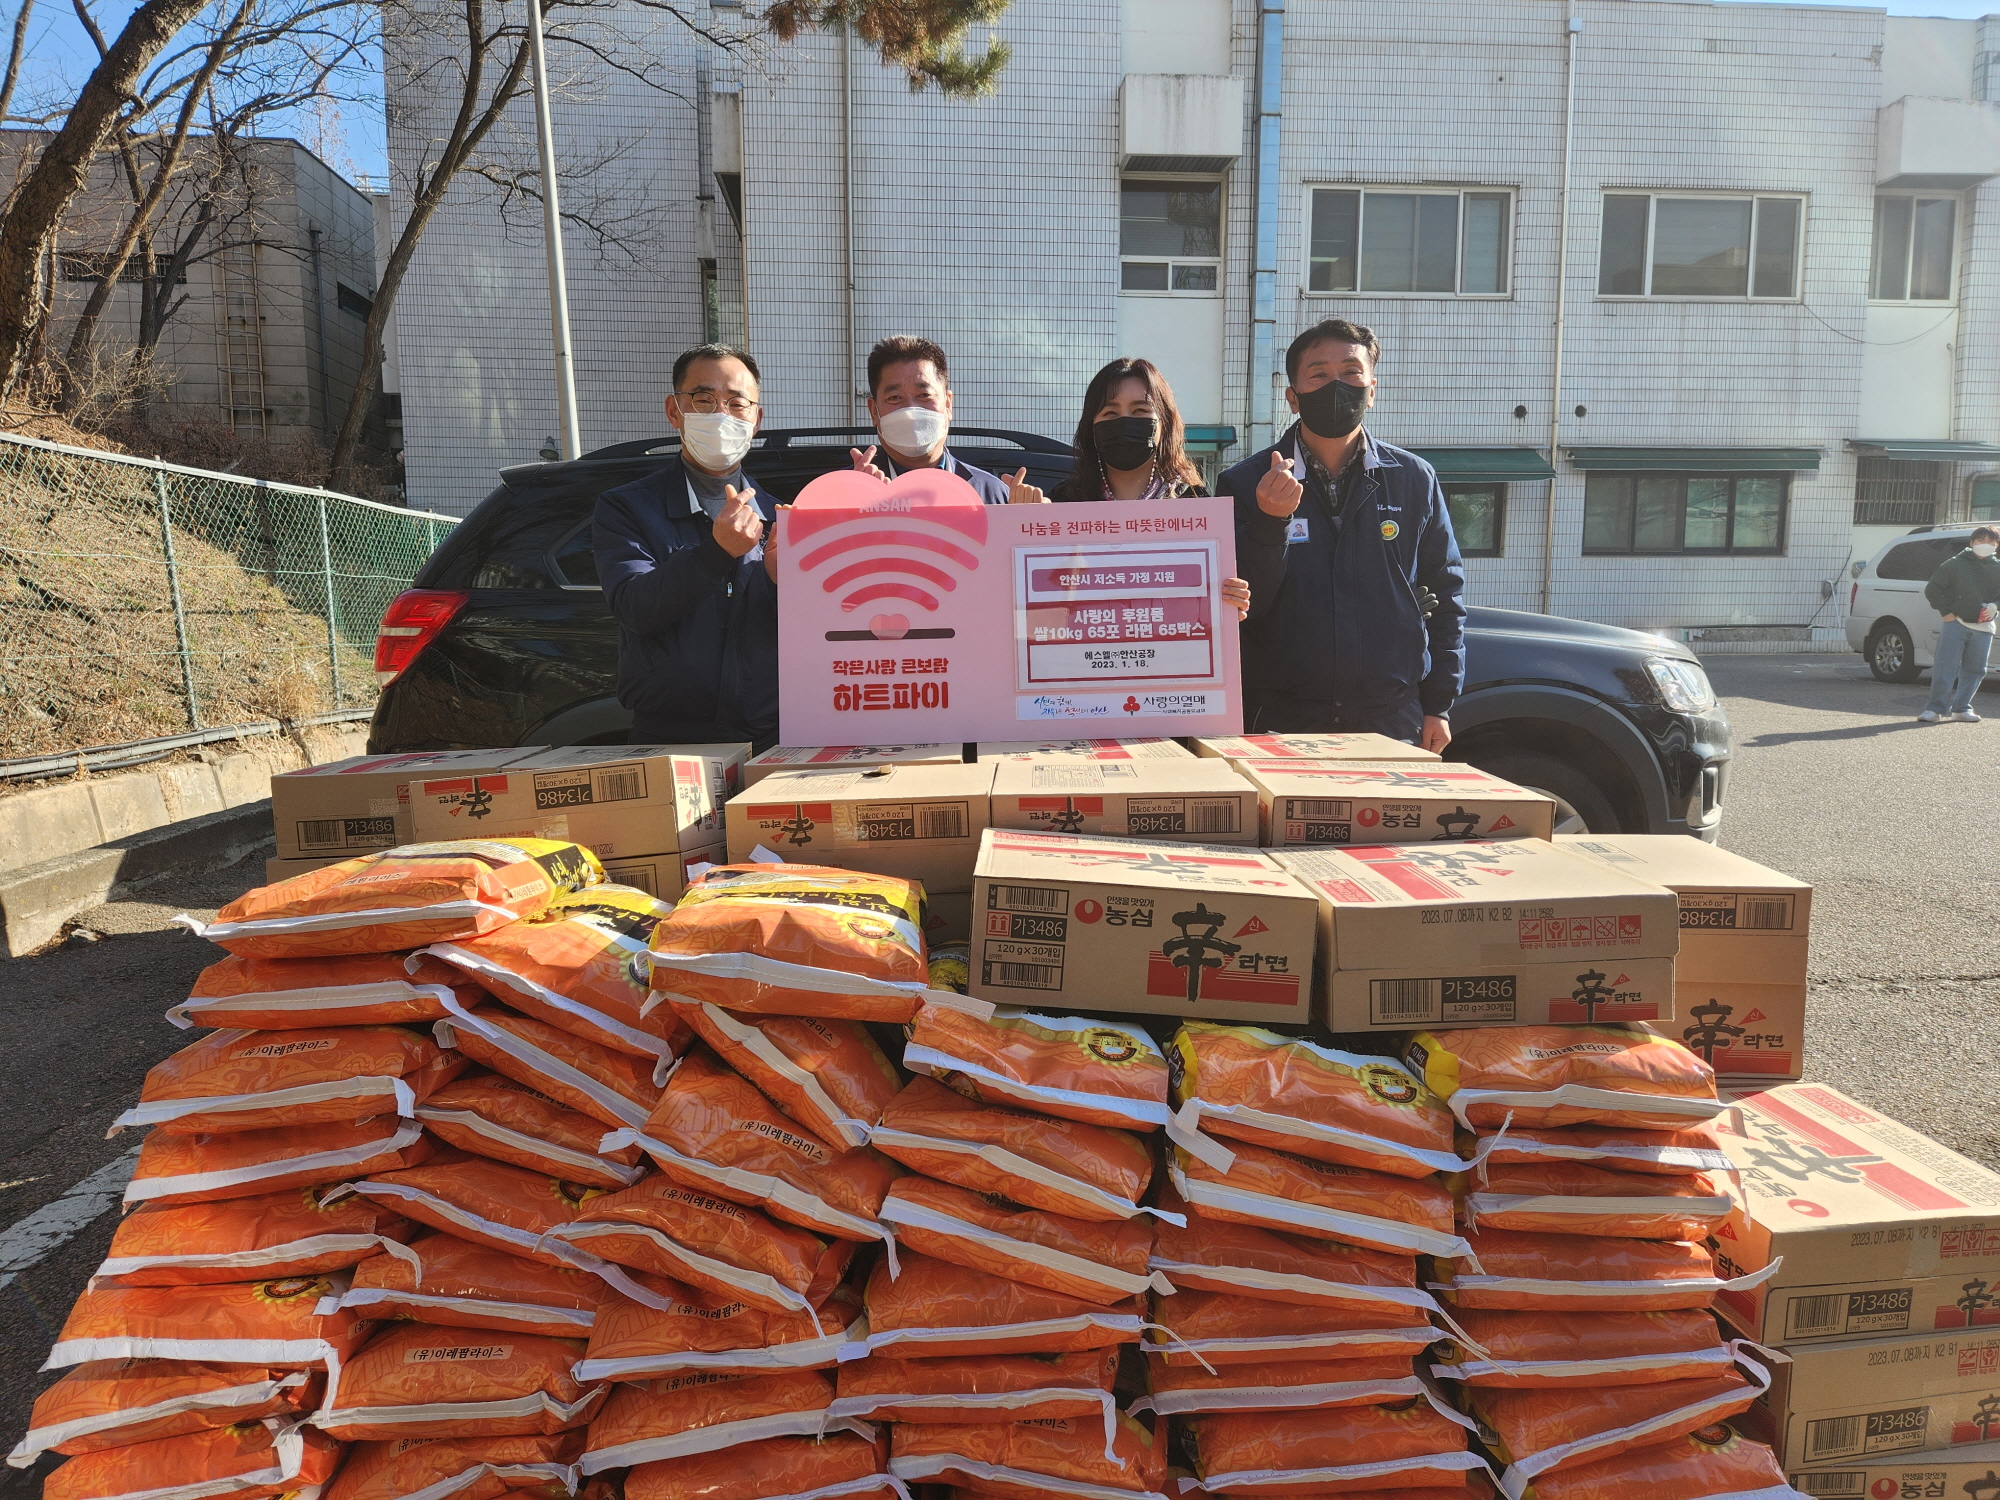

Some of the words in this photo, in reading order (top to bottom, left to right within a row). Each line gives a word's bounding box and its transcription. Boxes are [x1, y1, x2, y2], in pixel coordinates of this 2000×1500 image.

[859, 498, 911, 513] ANSAN
[1021, 521, 1062, 537] 나눔을
[1067, 519, 1121, 535] 전파하는
[1125, 516, 1208, 533] 따뜻한에너지
[1059, 573, 1091, 586] 안산시
[1094, 571, 1126, 585] 저소득
[1129, 571, 1151, 584] 가정
[1153, 570, 1175, 583] 지원
[1074, 608, 1116, 625] 사랑의
[1122, 607, 1164, 623] 후원품
[1033, 626, 1083, 642] 쌀10kg
[1087, 625, 1120, 640] 65포
[1125, 624, 1153, 638] 라면
[1158, 622, 1206, 637] 65박스
[900, 657, 949, 674] 큰보람
[1091, 660, 1118, 669] 2023.
[1121, 660, 1131, 669] 1.
[1134, 659, 1149, 668] 18.
[832, 681, 949, 712] 하트파이
[1143, 695, 1206, 709] 사랑의열매
[438, 794, 459, 804] 라면
[538, 787, 590, 806] 가3486
[1029, 811, 1052, 821] 라면
[1382, 804, 1401, 812] 인생을
[1402, 804, 1422, 813] 맛있게
[347, 820, 393, 834] 가3486
[759, 820, 781, 829] 라면
[1130, 816, 1183, 832] 가3486
[1381, 812, 1422, 829] 농심
[1499, 818, 1508, 826] 신
[860, 821, 912, 838] 가3486
[1307, 824, 1349, 840] 가3486
[1106, 895, 1130, 905] 인생을
[1131, 897, 1155, 908] 맛있게
[1105, 906, 1154, 928] 농심
[1421, 907, 1484, 924] 2023.07.08까지
[1488, 907, 1500, 922] K2
[1680, 911, 1734, 926] 가3486
[1013, 918, 1064, 937] 가3486
[1249, 920, 1260, 932] 신
[997, 944, 1015, 954] 120
[1162, 902, 1242, 1003] 辛
[1238, 952, 1289, 974] 라면
[1445, 980, 1513, 1000] 가3486
[1572, 968, 1616, 1022] 辛
[1614, 991, 1642, 1004] 라면
[1453, 1004, 1470, 1012] 120
[1750, 1011, 1759, 1020] 신
[1683, 998, 1746, 1068] 辛
[1743, 1033, 1784, 1049] 라면
[739, 1120, 824, 1160] (유)이레팜라이스
[662, 1188, 747, 1221] (유)이레팜라이스
[1851, 1292, 1909, 1312] 가3486
[1957, 1277, 1994, 1327] 辛
[1856, 1315, 1870, 1324] 120
[412, 1347, 504, 1360] (유)이레팜라이스
[1869, 1412, 1926, 1434] 가3486
[1874, 1435, 1888, 1444] 120
[1902, 1472, 1923, 1481] 인생을
[1924, 1471, 1948, 1480] 맛있게
[1900, 1480, 1946, 1499] 농심
